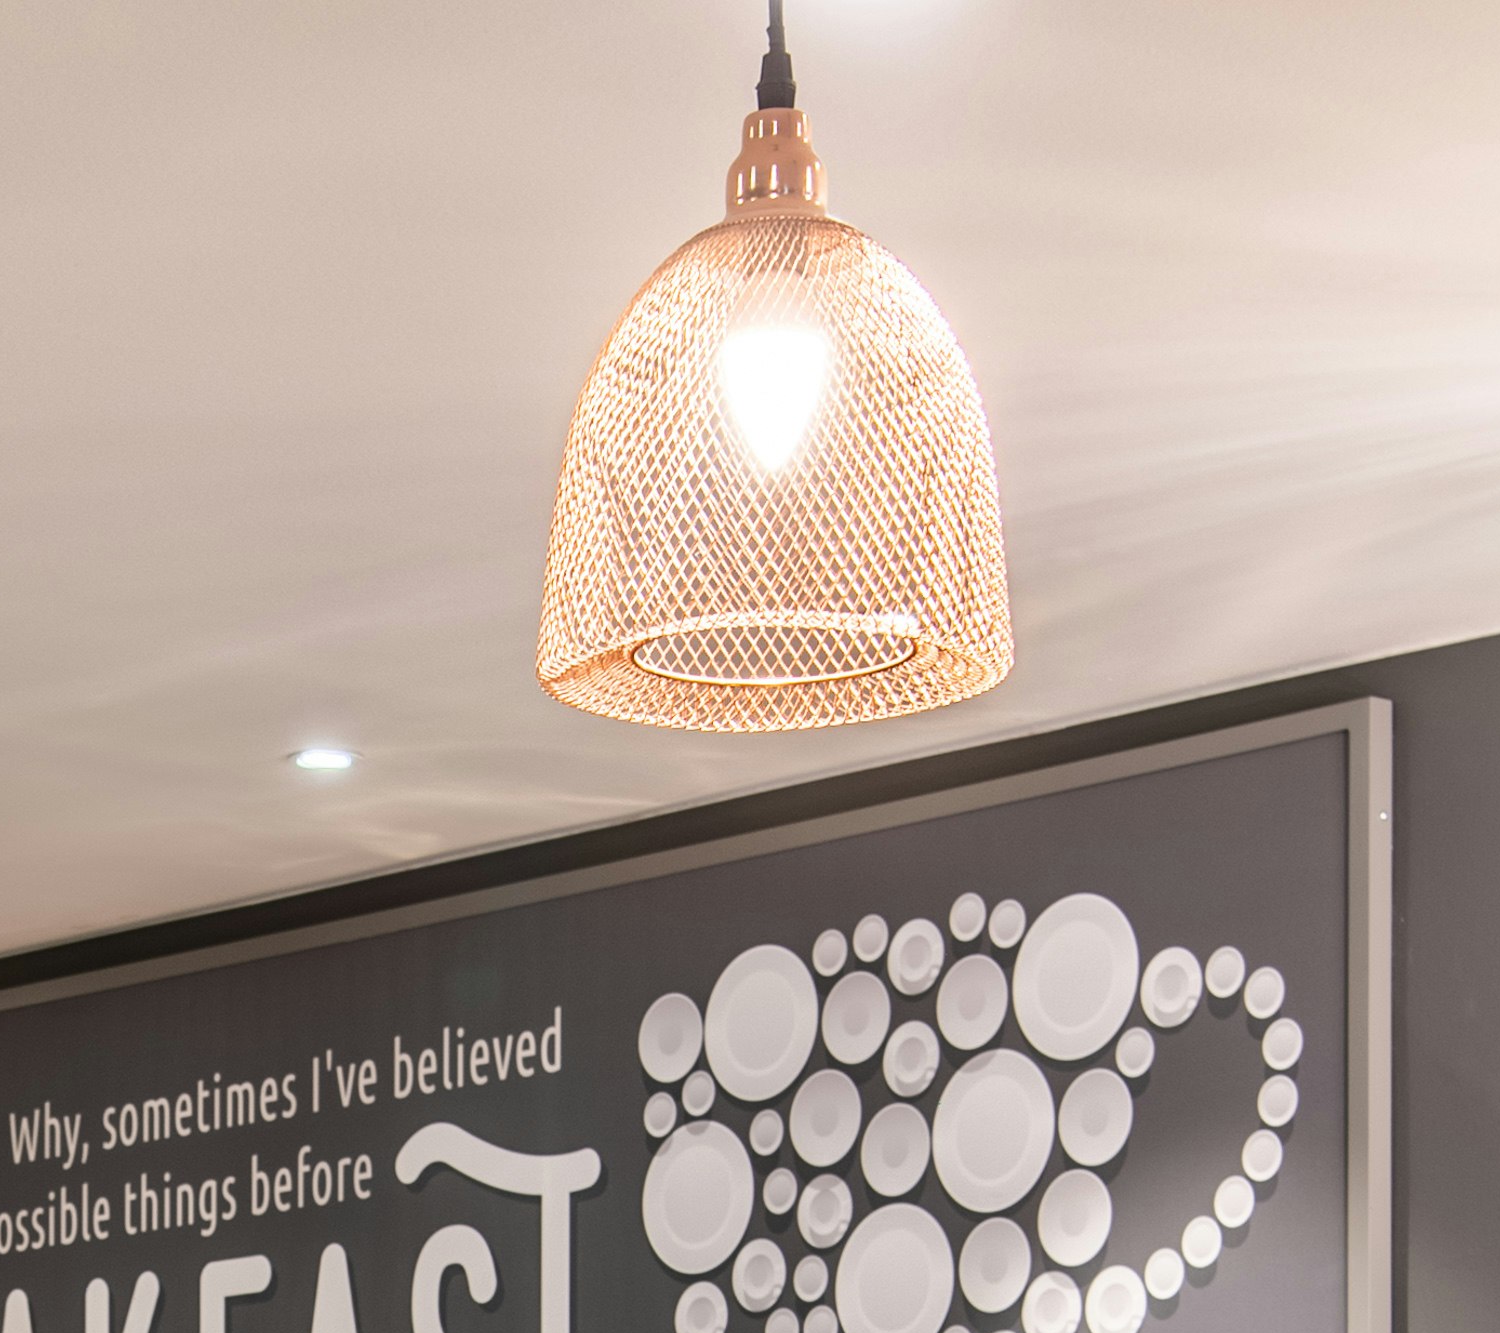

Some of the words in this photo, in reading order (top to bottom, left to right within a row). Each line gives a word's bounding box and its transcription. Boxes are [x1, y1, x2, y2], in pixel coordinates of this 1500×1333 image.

[9, 1101, 90, 1170] Why,
[102, 1072, 298, 1150] sometimes
[312, 1049, 378, 1114] I've
[393, 1005, 562, 1100] believed
[124, 1172, 238, 1238] things
[251, 1145, 374, 1216] before
